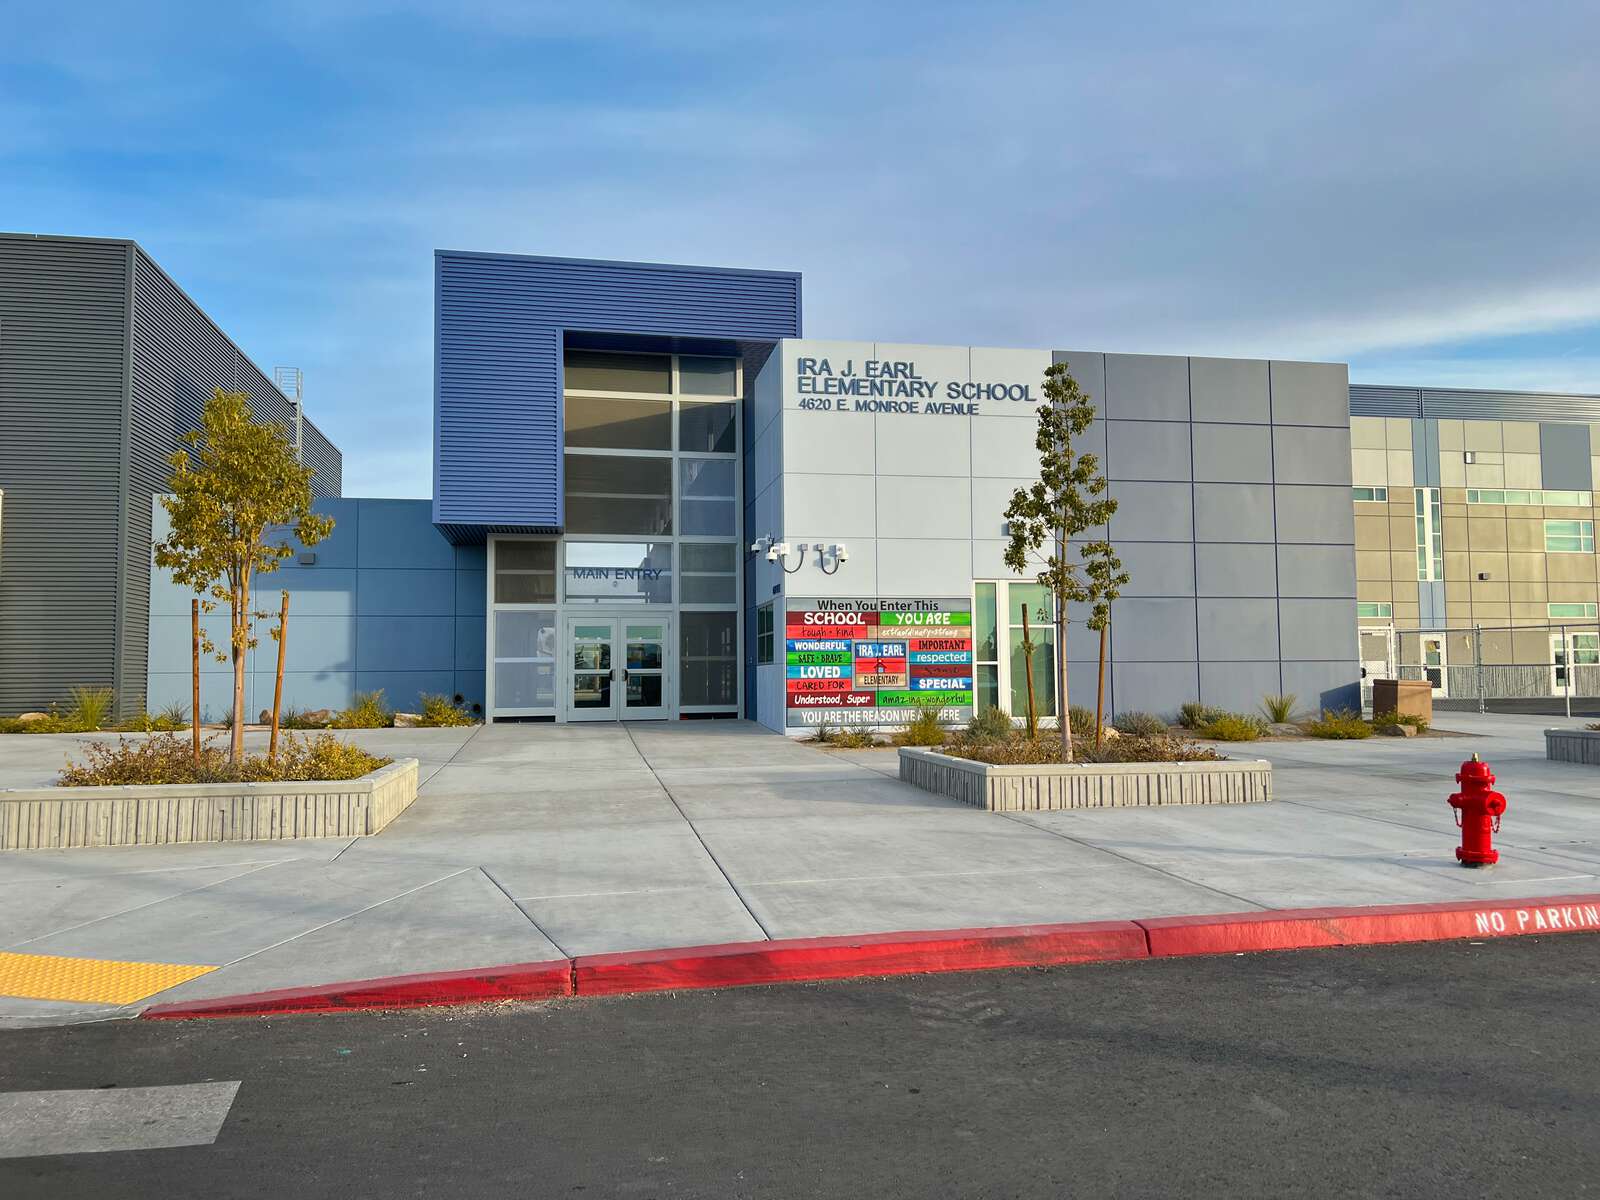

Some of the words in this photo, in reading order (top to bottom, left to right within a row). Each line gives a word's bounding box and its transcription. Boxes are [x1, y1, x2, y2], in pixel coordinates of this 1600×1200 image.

[797, 357, 833, 376] IRA
[841, 359, 857, 377] J.
[865, 360, 922, 380] EARL
[797, 376, 938, 399] ELEMENTARY
[946, 381, 1037, 402] SCHOOL
[798, 398, 831, 411] 4620
[836, 400, 850, 411] E.
[855, 400, 919, 414] MONROE
[924, 402, 980, 416] AVENUE
[573, 568, 609, 580] MAIN
[615, 568, 662, 580] ENTRY
[817, 600, 852, 611] When
[855, 600, 877, 611] You
[880, 600, 912, 611] Enter
[914, 600, 939, 611] This
[804, 612, 866, 625] SCHOOL
[895, 612, 924, 625] YOU
[925, 612, 951, 625] ARE
[794, 641, 847, 651] WONDERFUL
[859, 644, 874, 656] IRA
[882, 644, 904, 656] EARL
[918, 640, 965, 650] IMPORTANT
[917, 652, 966, 664] respected
[800, 666, 841, 679] LOVED
[796, 681, 825, 691] CARED
[827, 681, 845, 689] FOR
[863, 675, 899, 685] ELEMENTARY
[918, 678, 966, 689] SPECIAL
[794, 694, 843, 705] Understood,
[847, 694, 871, 706] Super
[801, 711, 822, 723] YOU
[823, 711, 842, 723] ARE
[842, 711, 861, 723] THE
[862, 710, 900, 722] REASON
[900, 709, 917, 722] WE
[1475, 911, 1506, 933] NO
[1516, 906, 1600, 930] PARKIN
